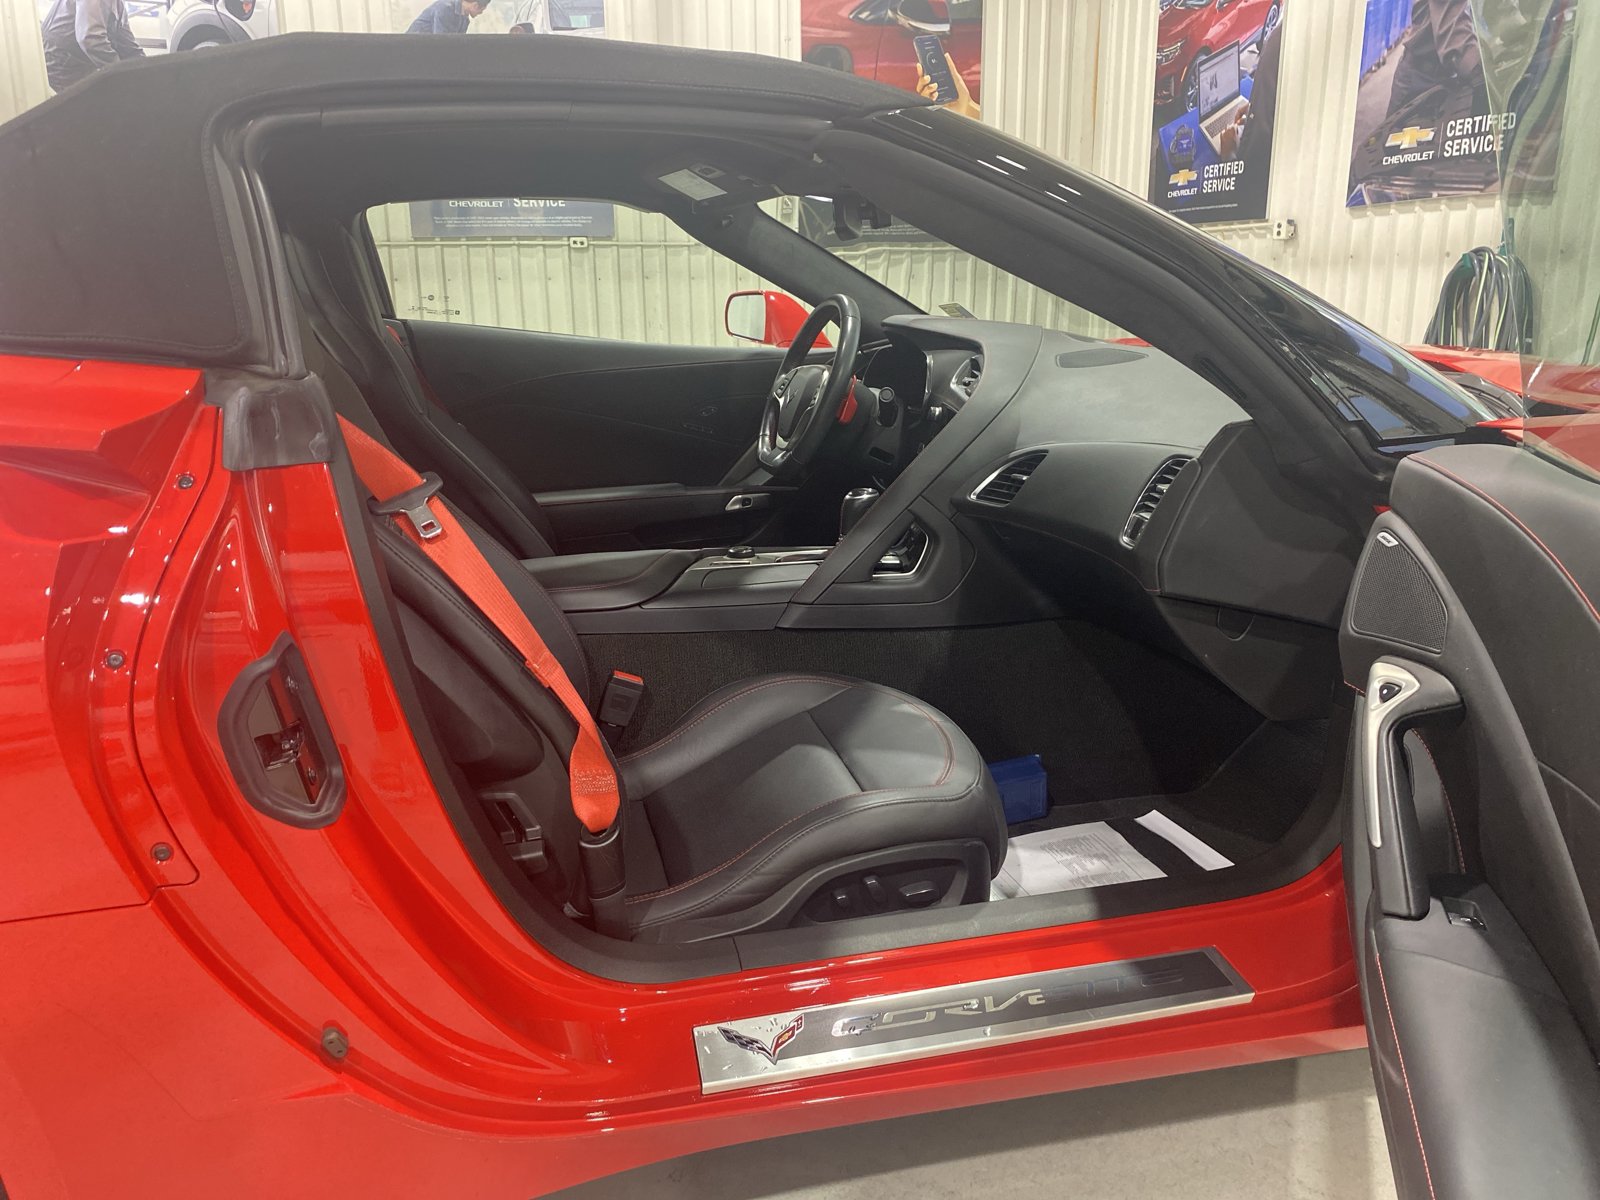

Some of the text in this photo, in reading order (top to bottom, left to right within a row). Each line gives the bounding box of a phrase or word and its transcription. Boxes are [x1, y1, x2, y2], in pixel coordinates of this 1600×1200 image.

[1446, 112, 1517, 138] CERTIFIED
[1443, 134, 1505, 158] SERVICE
[1382, 150, 1435, 165] CHEVROLET
[1203, 160, 1245, 179] CERTIFIED
[1167, 187, 1198, 198] CHEVROLET
[1202, 177, 1236, 193] SERVICE
[448, 200, 504, 208] CHEVROLET
[831, 970, 1184, 1037] CORVETTE
